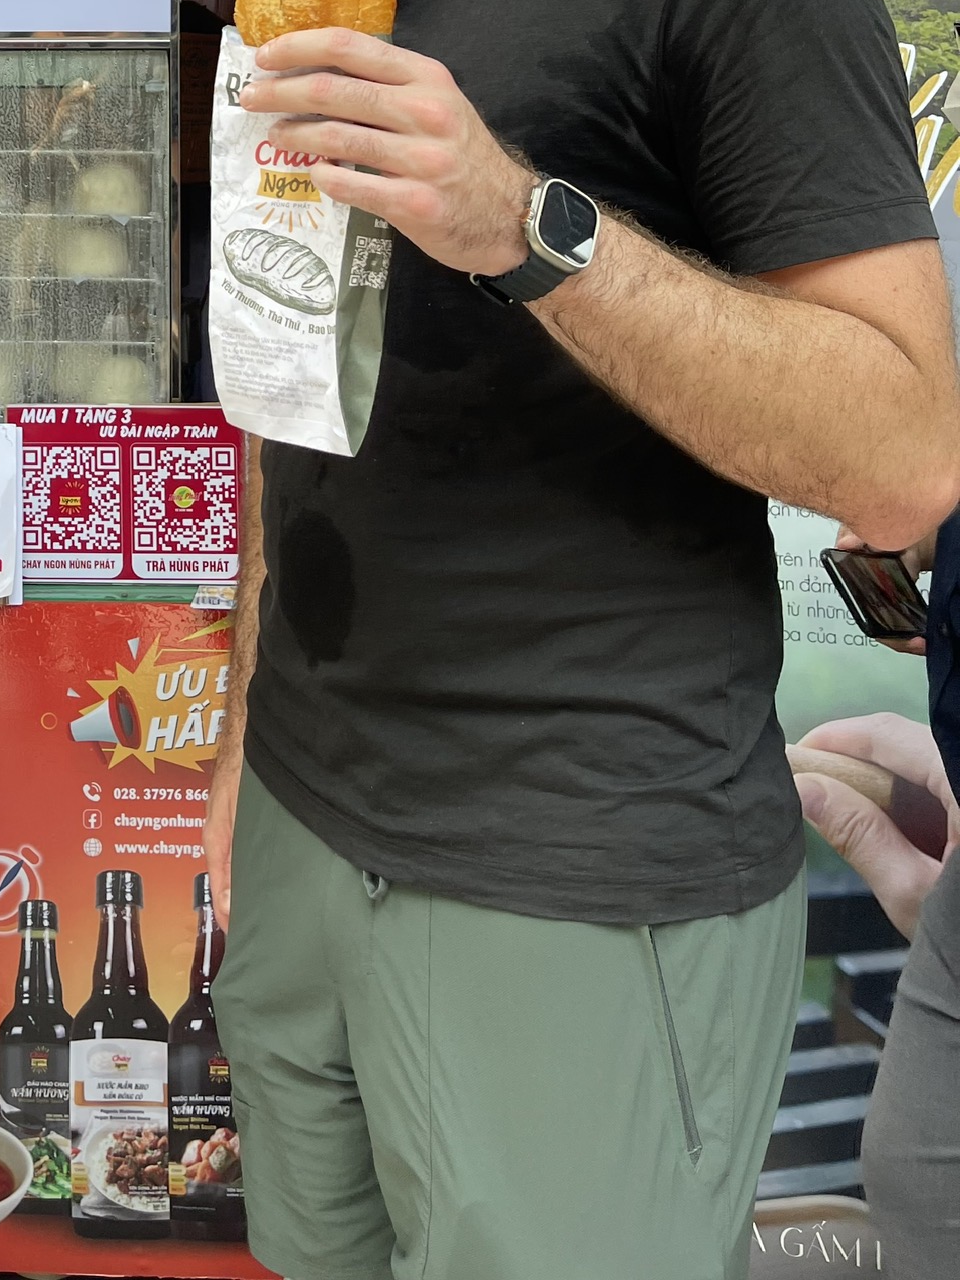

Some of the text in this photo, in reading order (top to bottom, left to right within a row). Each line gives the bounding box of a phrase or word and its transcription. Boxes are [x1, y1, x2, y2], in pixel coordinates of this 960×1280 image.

[267, 309, 284, 325] Tha
[308, 323, 326, 335] Bao
[20, 408, 57, 424] MUA
[61, 408, 69, 423] 1
[120, 408, 133, 423] 3
[144, 425, 180, 440] NGẬP
[183, 424, 218, 439] TRÀN
[768, 504, 790, 519] ạn
[43, 559, 67, 570] NGON
[69, 558, 92, 570] HÙNG
[94, 558, 116, 570] PHÁT
[146, 558, 230, 573] TRÀ HÙNG PHÁT
[787, 601, 800, 617] từ
[807, 627, 836, 644] của
[155, 663, 208, 701] ƯU
[113, 787, 209, 801] 028. 37976 866
[779, 1220, 861, 1268] GẤM
